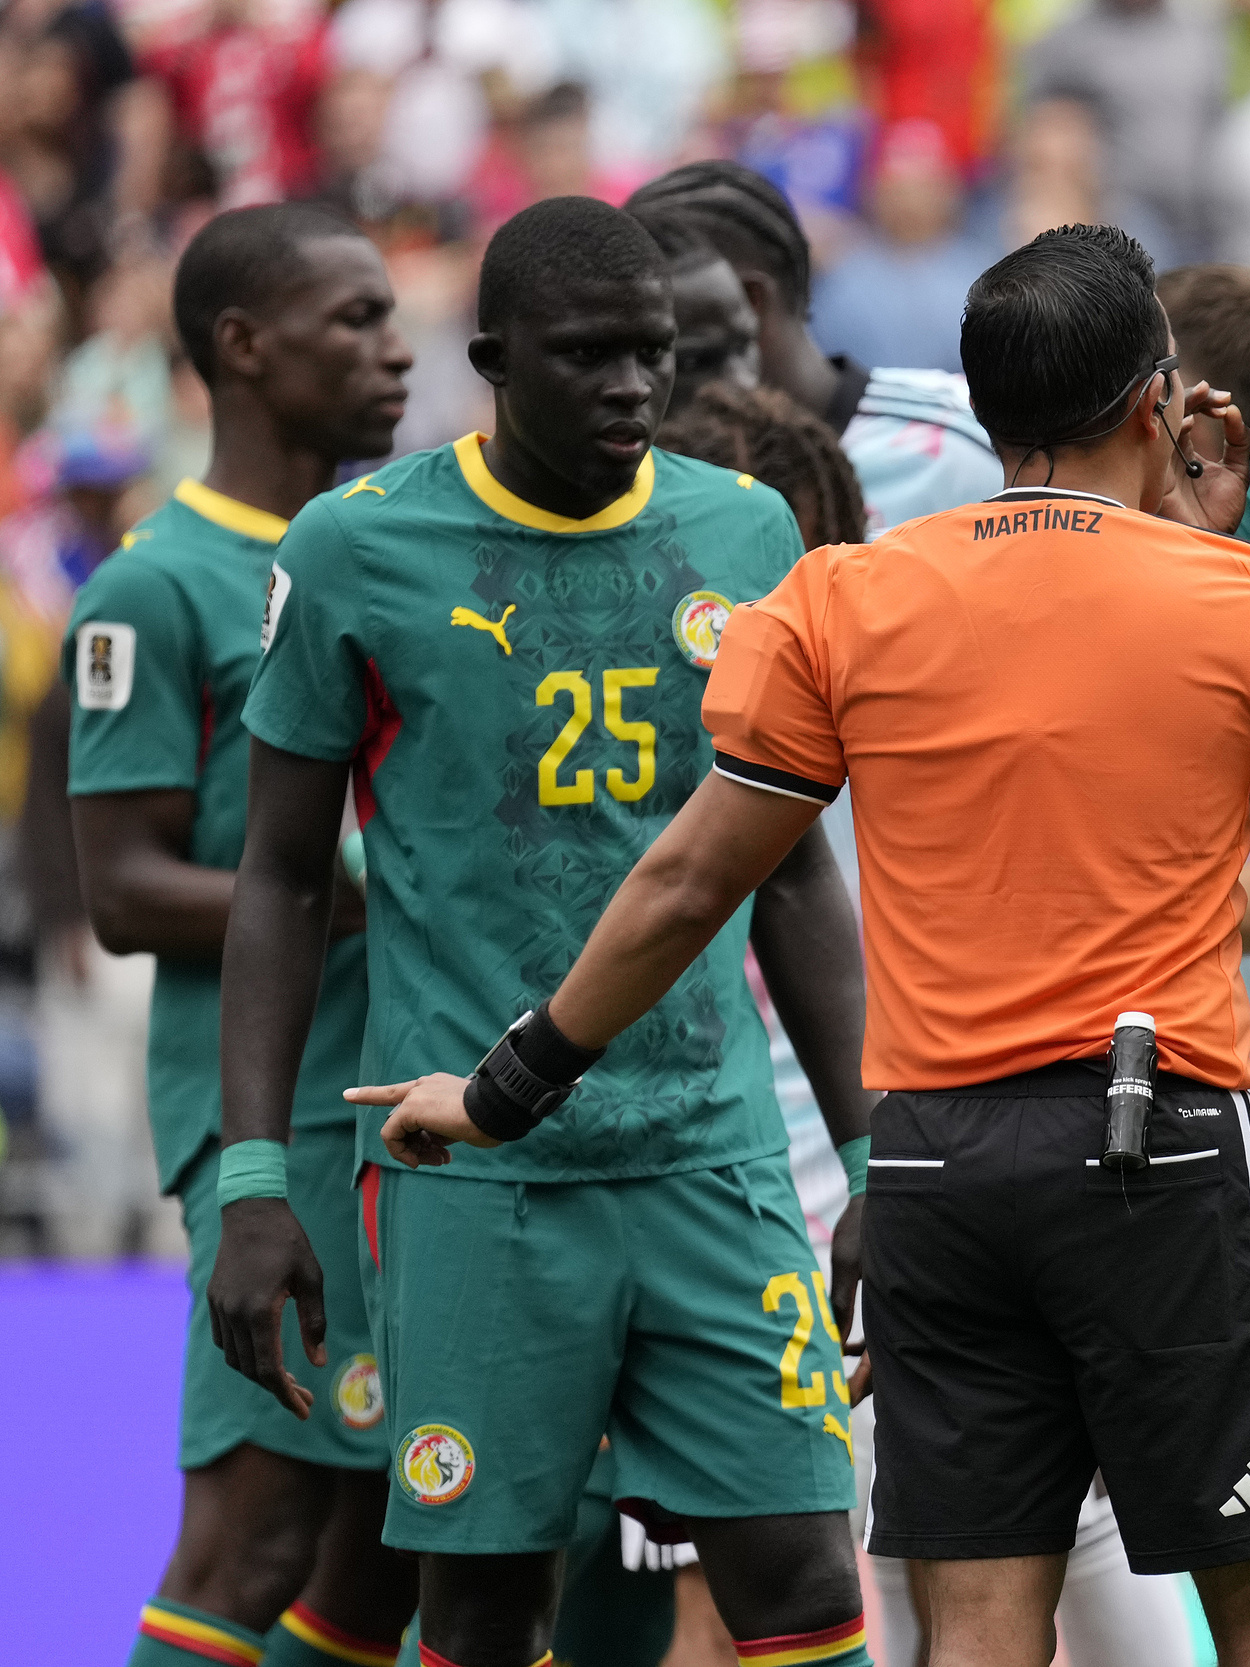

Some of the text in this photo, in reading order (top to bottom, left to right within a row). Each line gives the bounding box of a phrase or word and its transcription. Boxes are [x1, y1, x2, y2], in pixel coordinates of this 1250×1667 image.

[973, 504, 1103, 540] MARTÍNEZ
[535, 667, 660, 807] 25
[1107, 1084, 1153, 1100] REFEREE
